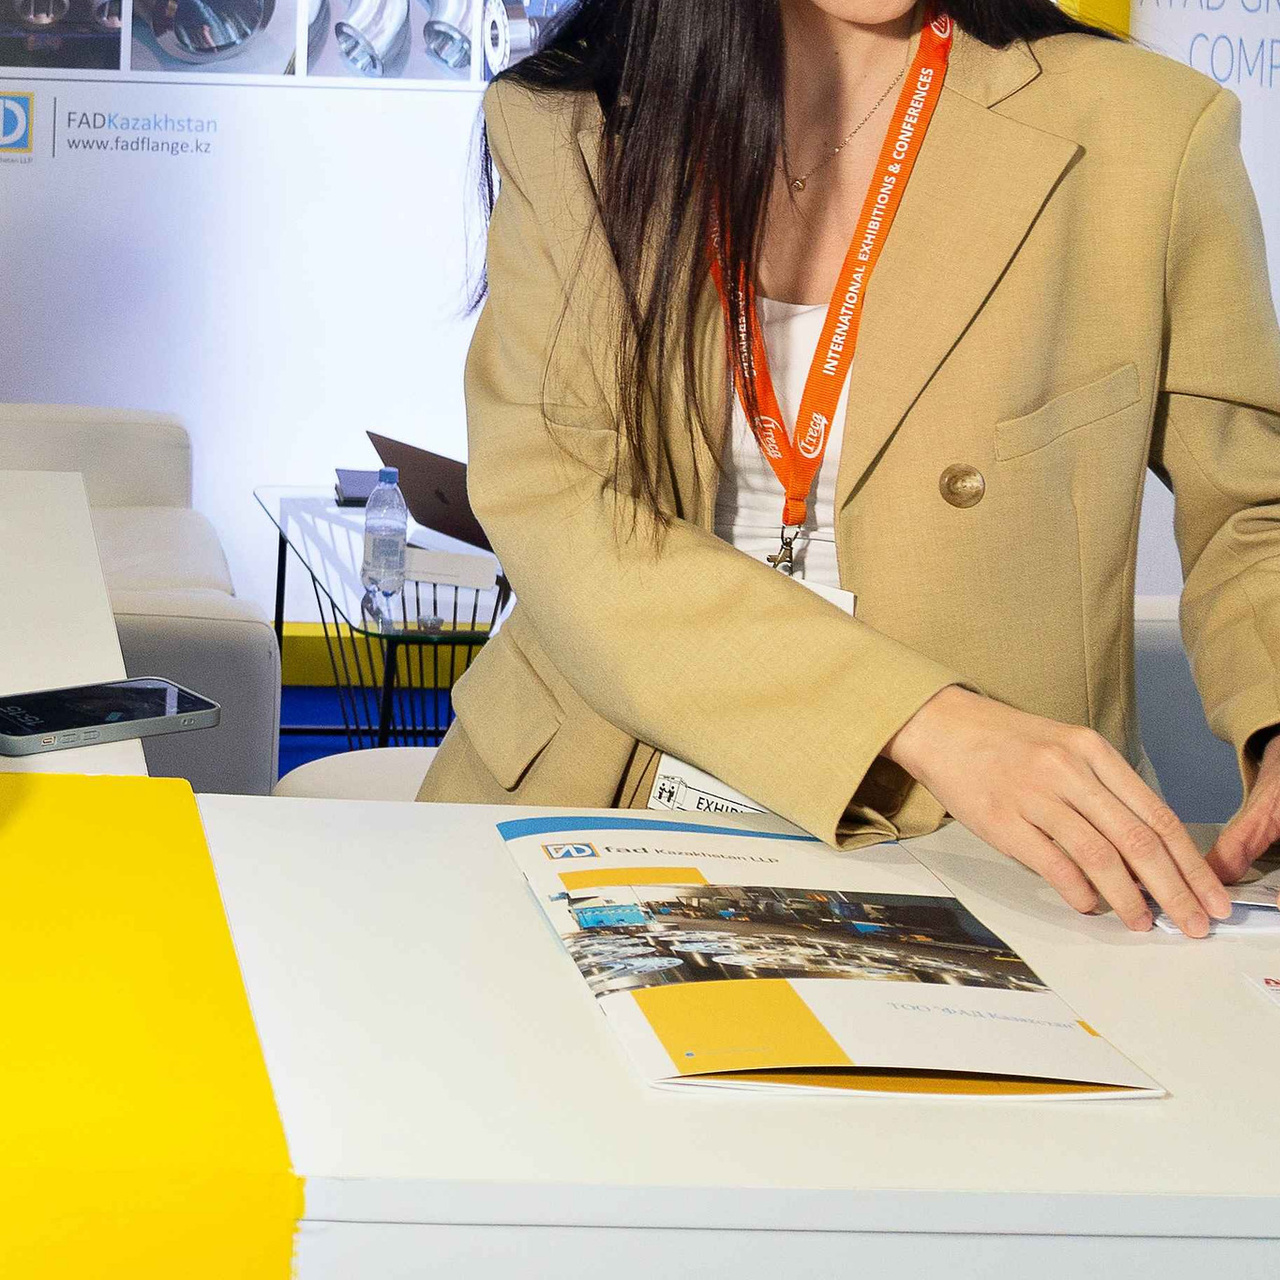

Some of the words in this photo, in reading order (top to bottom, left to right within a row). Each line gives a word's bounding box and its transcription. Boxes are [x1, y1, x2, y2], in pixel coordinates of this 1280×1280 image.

[67, 111, 219, 134] FADKazakhstan
[892, 66, 934, 161] CONFERENCES
[66, 136, 212, 157] www.fadflange.kz
[887, 162, 902, 175] &
[856, 175, 896, 262] EXHIBITIONS
[822, 264, 866, 376] INTERNATIONAL
[604, 845, 649, 855] fad
[654, 848, 748, 862] Kazakhstan
[749, 855, 780, 865] LLP
